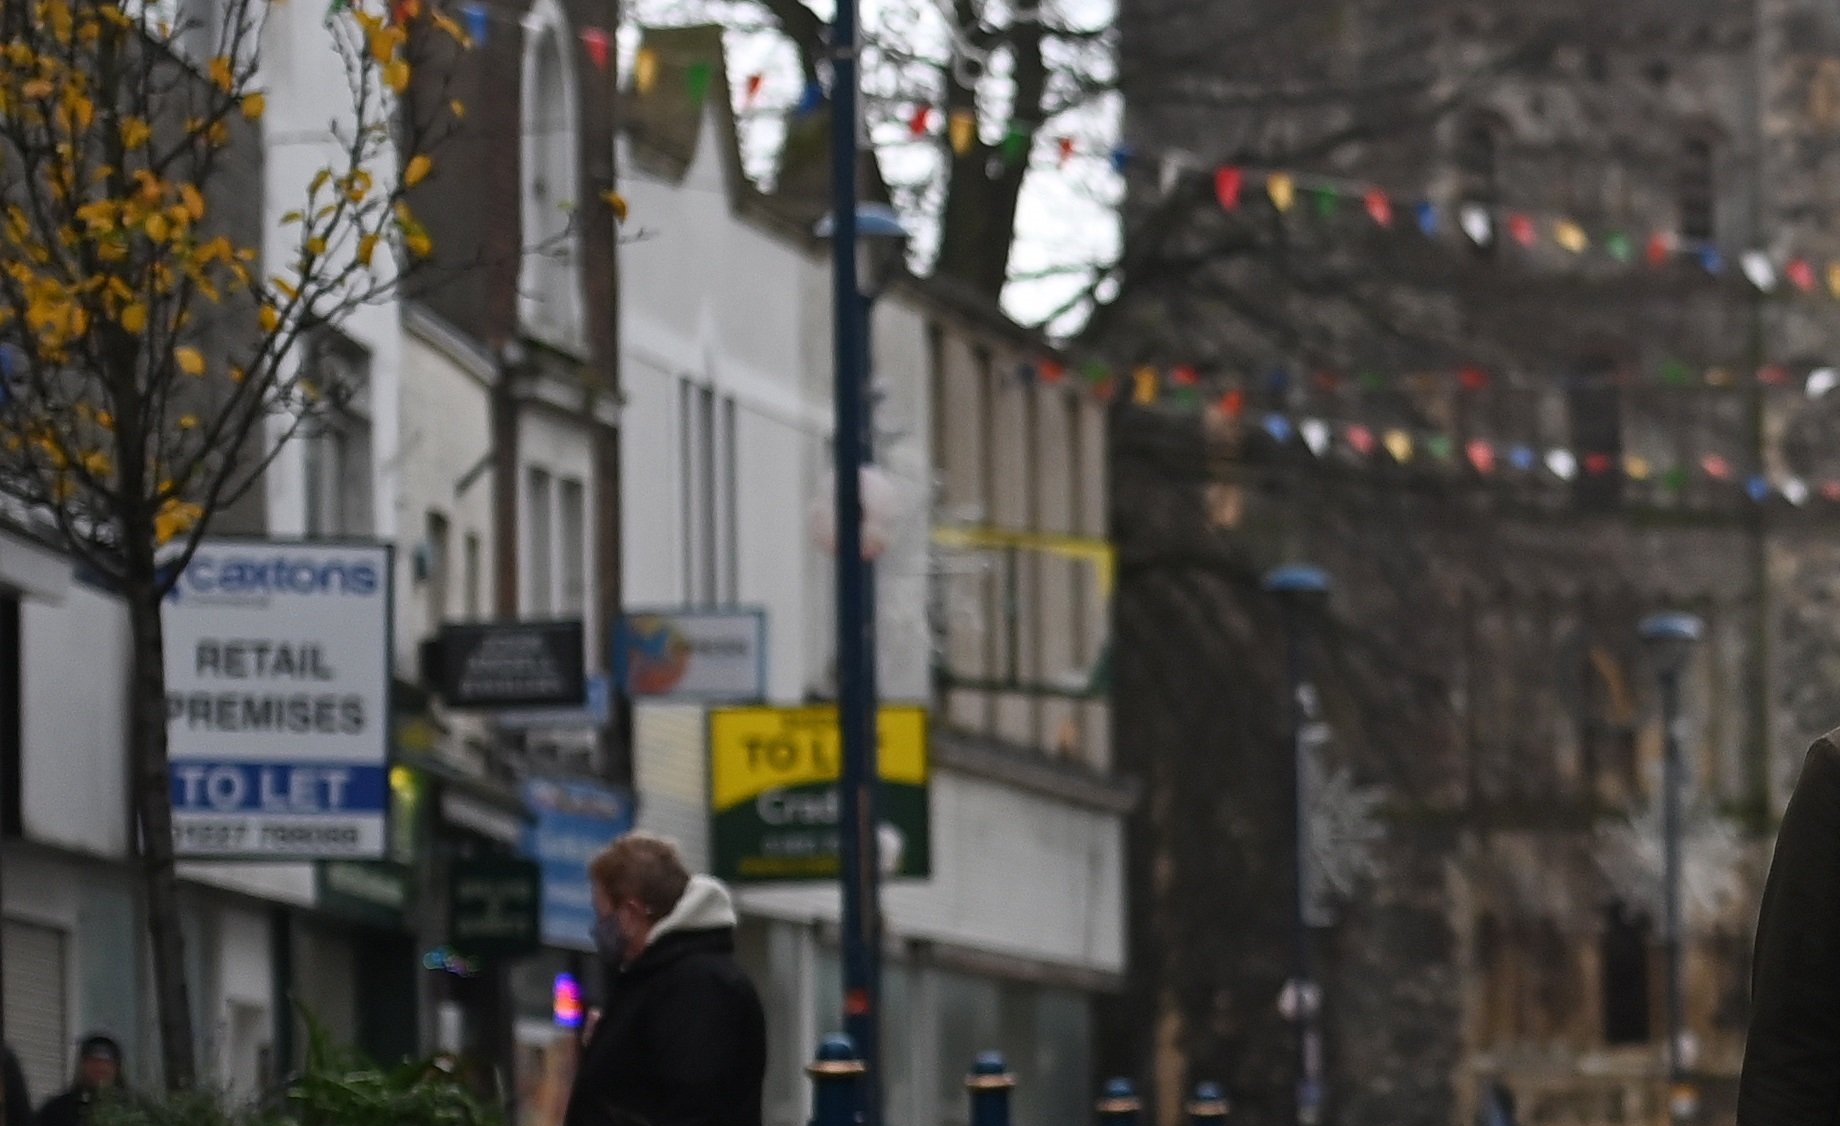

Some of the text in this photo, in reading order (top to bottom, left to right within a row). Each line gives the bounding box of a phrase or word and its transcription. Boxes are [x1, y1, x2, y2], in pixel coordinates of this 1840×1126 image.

[185, 556, 378, 594] caxtons
[195, 638, 334, 681] RETAIL
[167, 690, 363, 735] PREMISES
[744, 735, 799, 772] TO
[177, 765, 350, 813] TO LET
